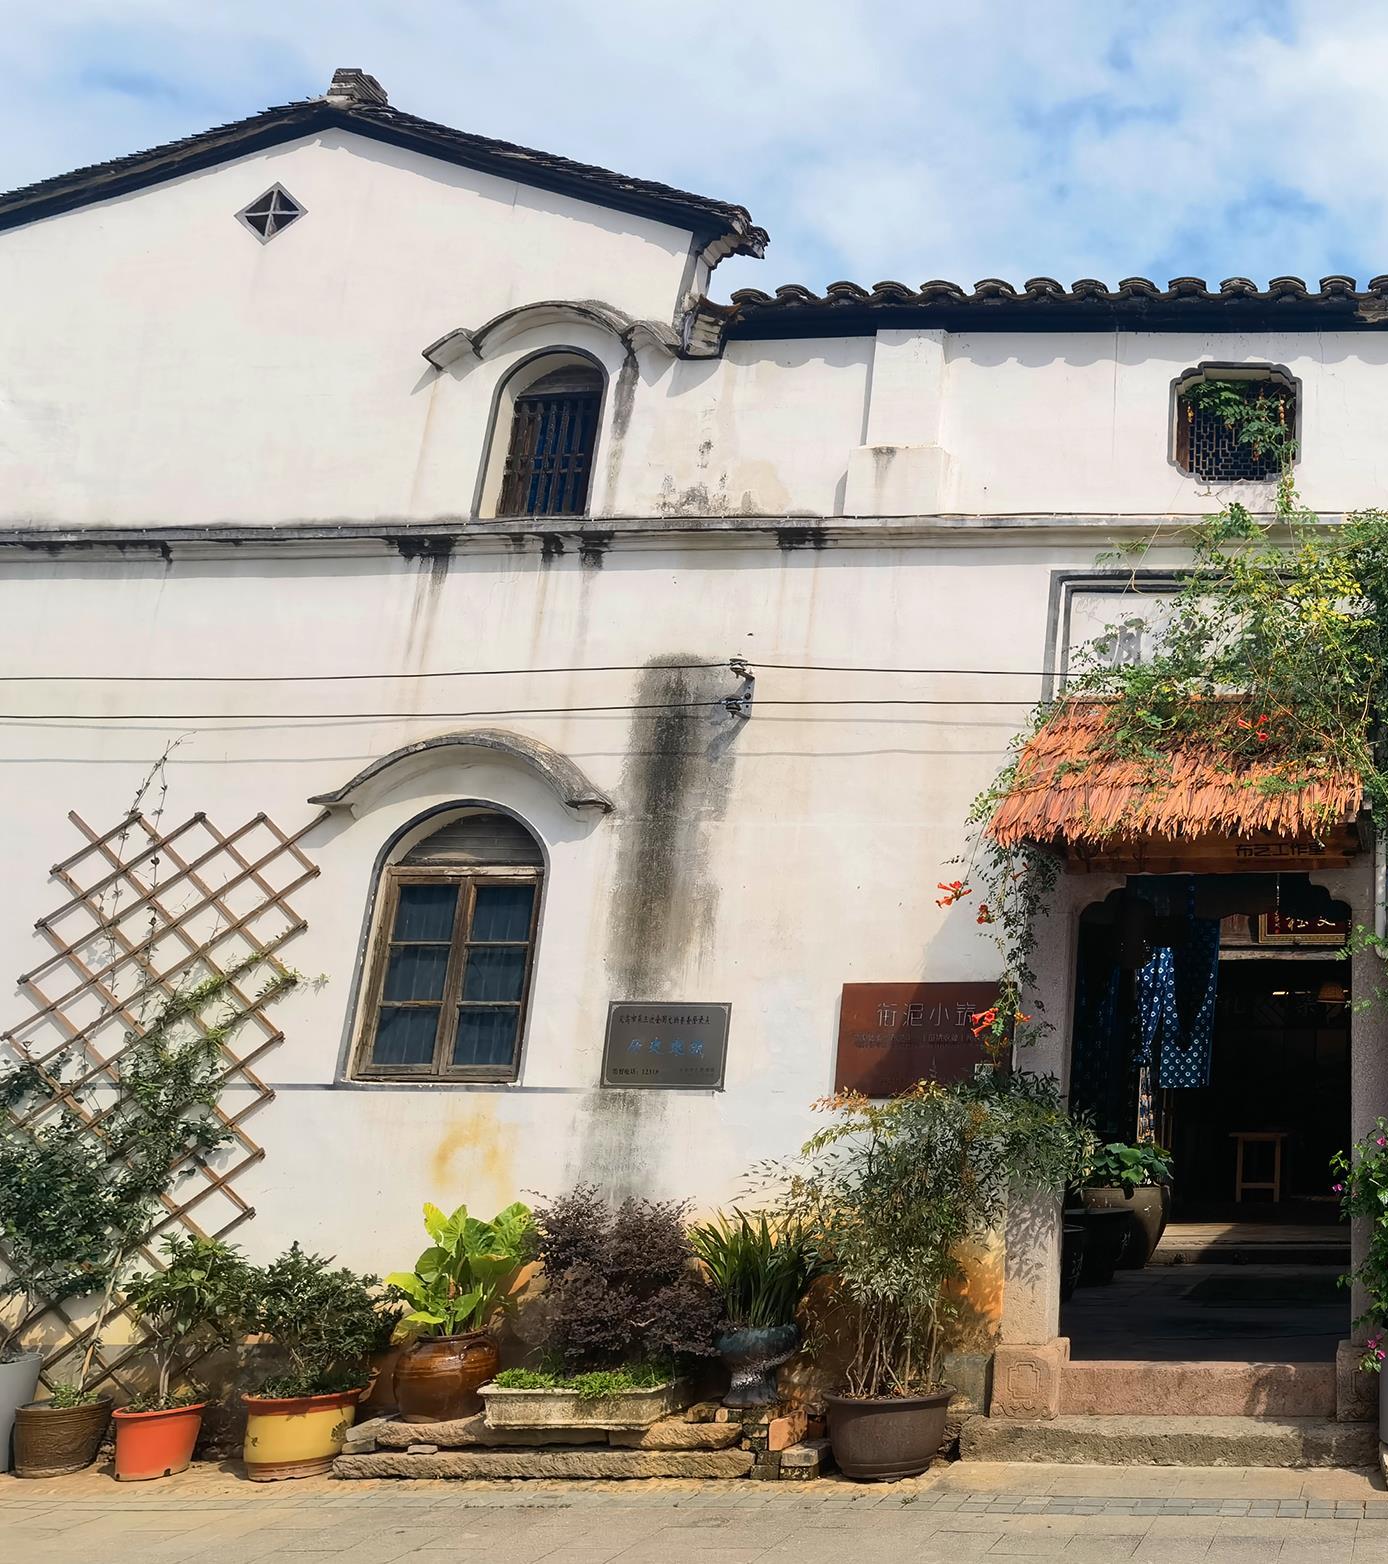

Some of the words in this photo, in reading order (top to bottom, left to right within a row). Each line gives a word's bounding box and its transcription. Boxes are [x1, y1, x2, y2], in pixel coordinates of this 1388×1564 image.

[1235, 842, 1326, 857] 布艺工作室
[876, 1001, 977, 1027] 衔泥小筑
